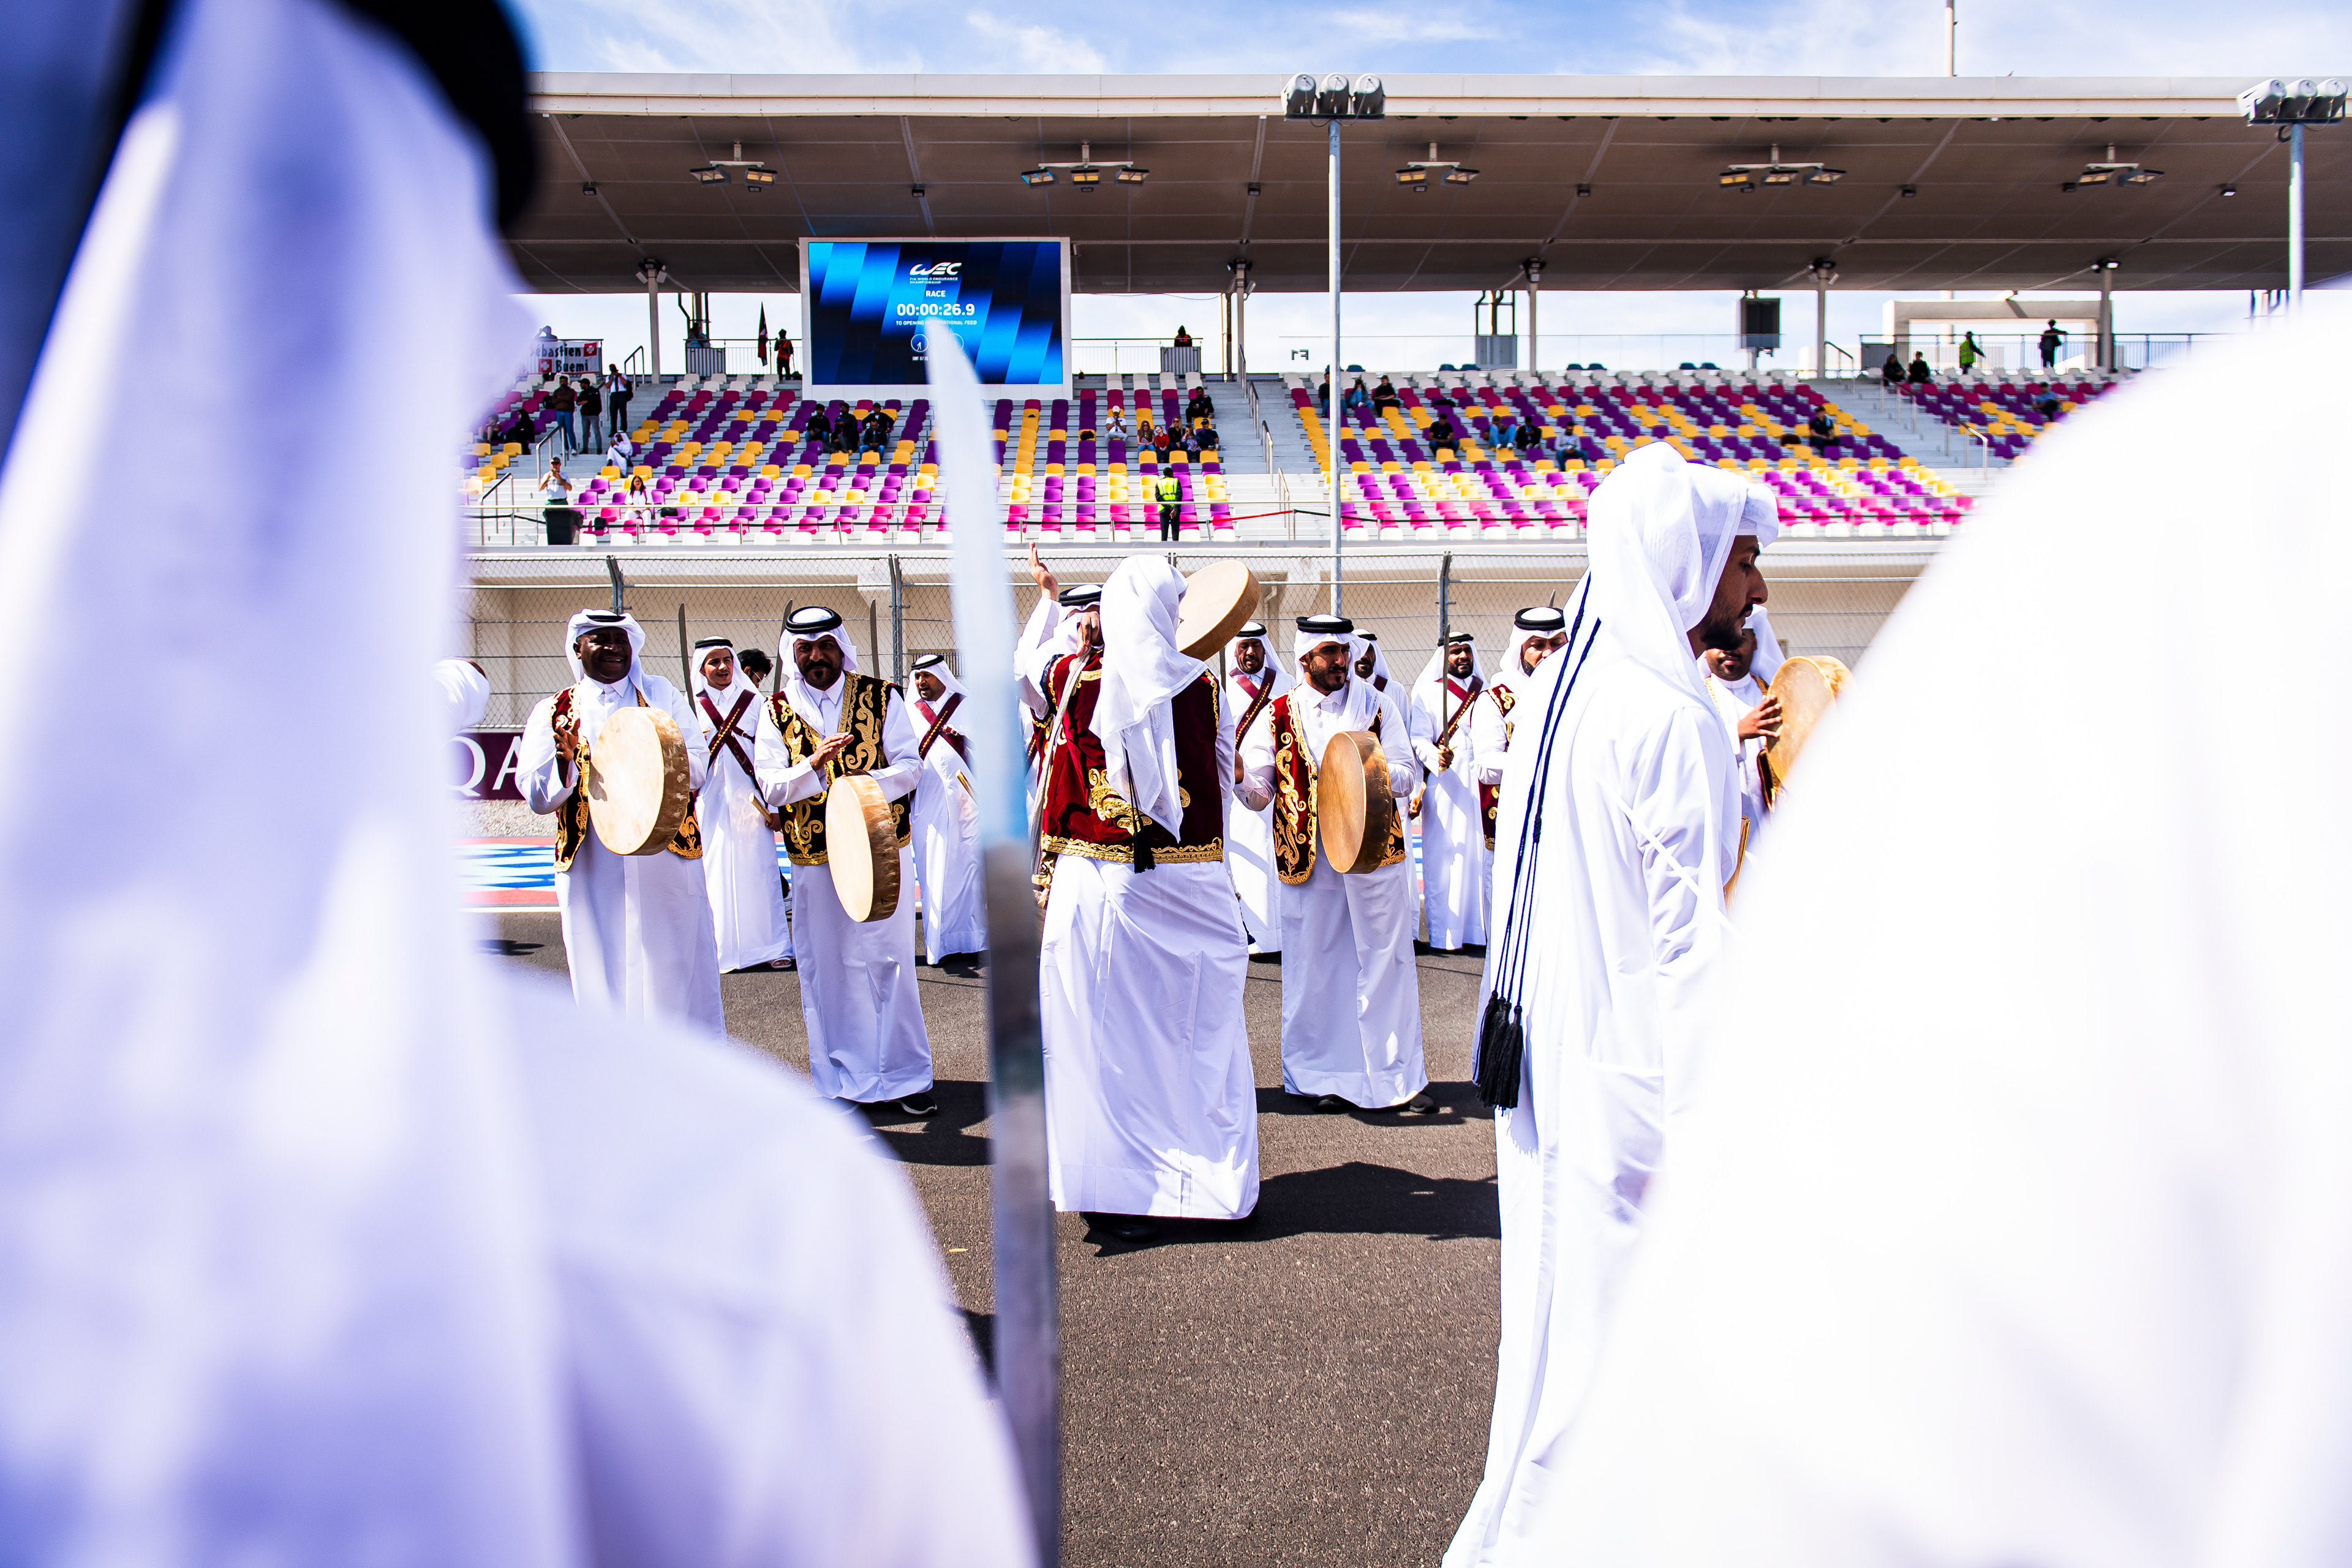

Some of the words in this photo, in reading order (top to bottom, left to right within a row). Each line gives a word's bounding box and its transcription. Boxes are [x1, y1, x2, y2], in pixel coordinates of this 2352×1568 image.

[910, 262, 962, 276] WEC
[897, 303, 975, 316] 00:00:26.9
[555, 359, 588, 372] Buemi
